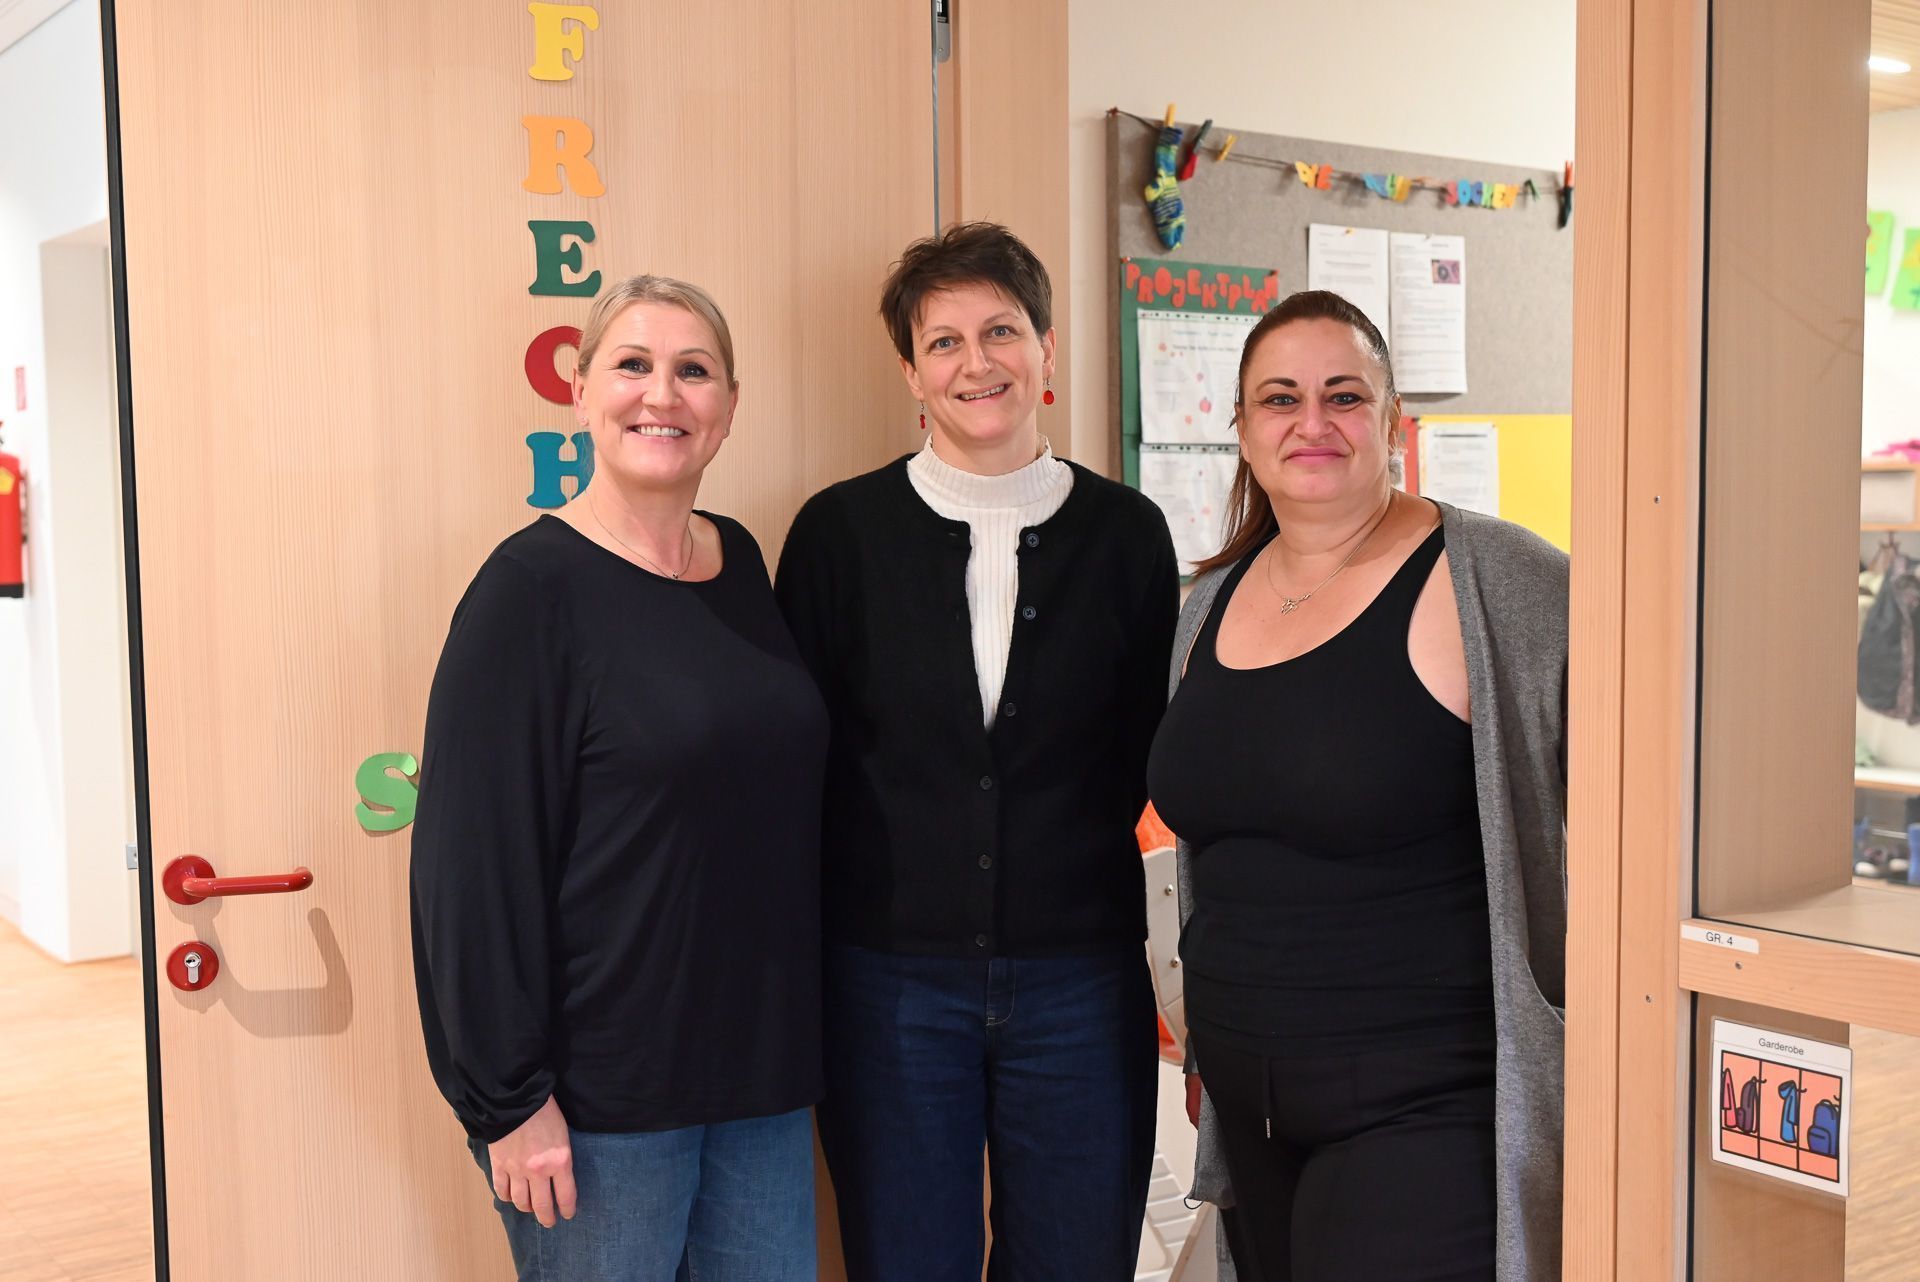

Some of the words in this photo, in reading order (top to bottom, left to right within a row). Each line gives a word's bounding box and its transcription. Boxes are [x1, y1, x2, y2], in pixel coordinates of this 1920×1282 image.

[1125, 263, 1279, 313] PROJEKTPLAN
[1705, 931, 1724, 944] GR.
[1726, 936, 1734, 946] 4
[1758, 1038, 1805, 1056] Garderobe
